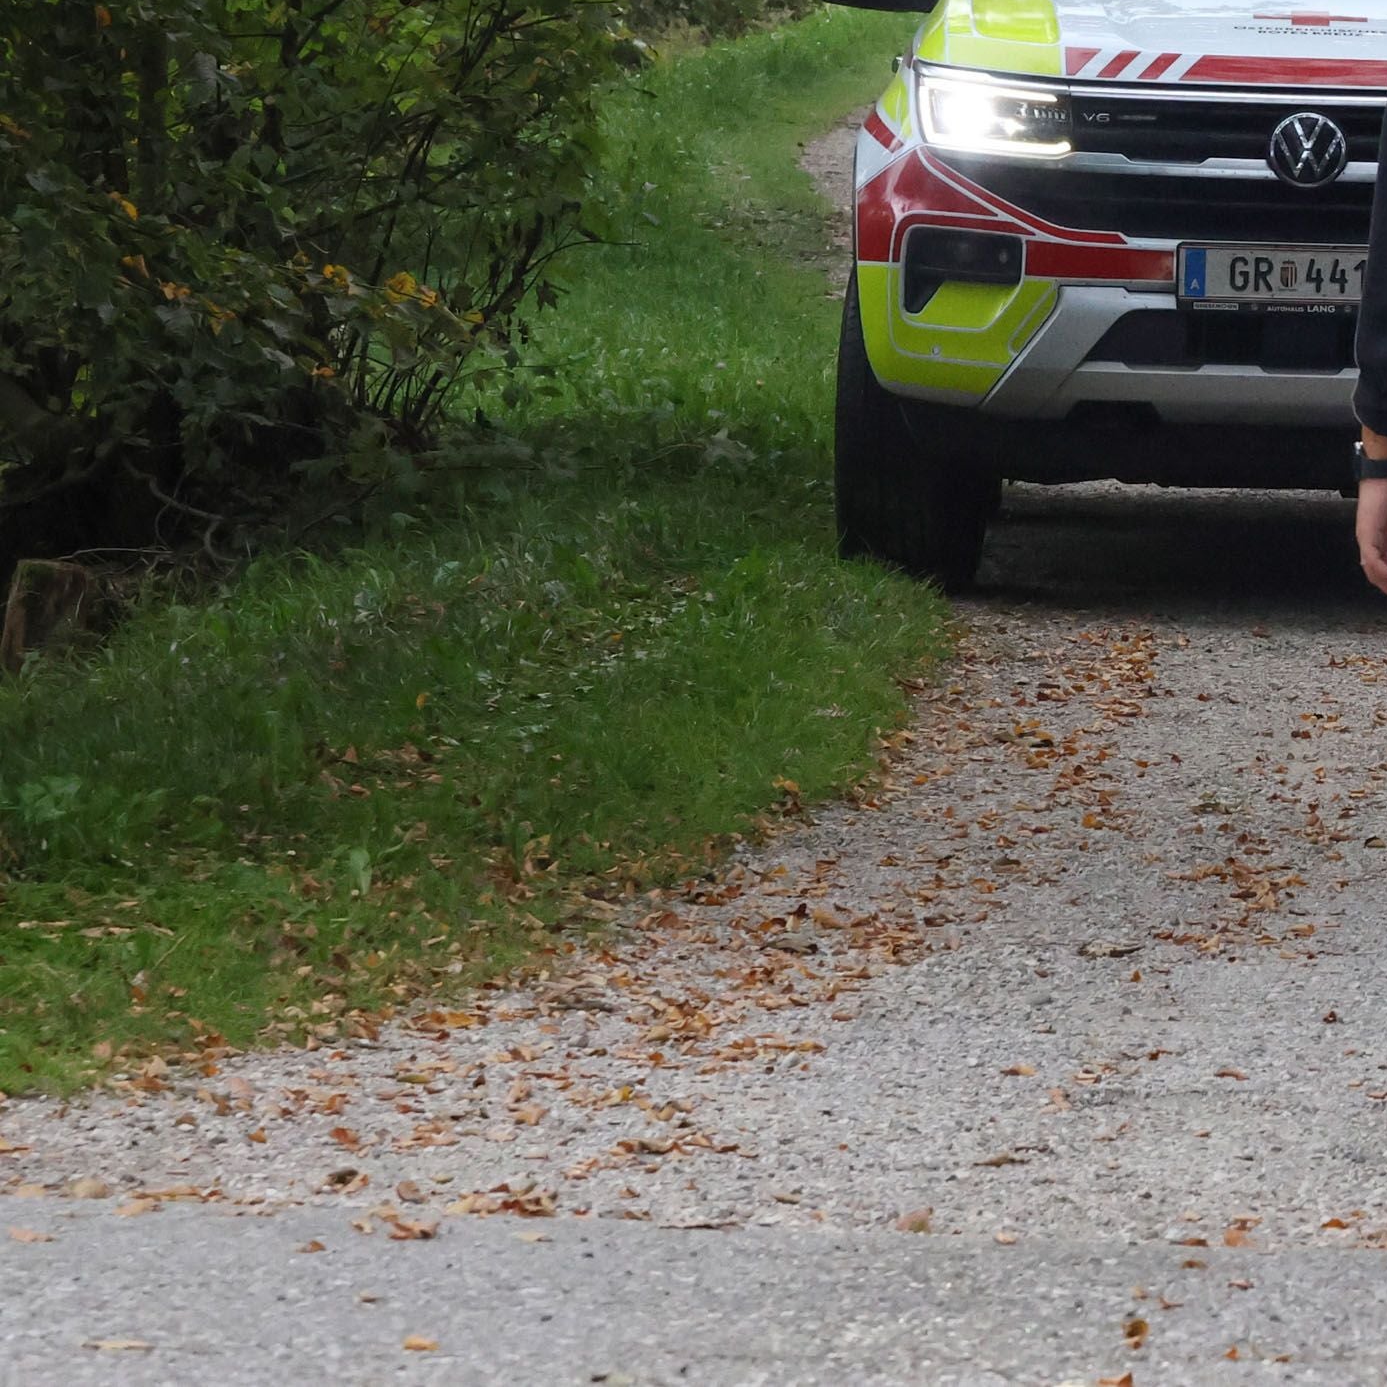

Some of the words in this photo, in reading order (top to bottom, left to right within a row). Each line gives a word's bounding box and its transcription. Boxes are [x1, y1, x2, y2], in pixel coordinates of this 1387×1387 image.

[1083, 112, 1111, 124] V6
[1229, 256, 1274, 293] GR
[1190, 277, 1200, 290] A
[1266, 305, 1304, 313] AUTOHAUS
[1306, 304, 1336, 314] LANG
